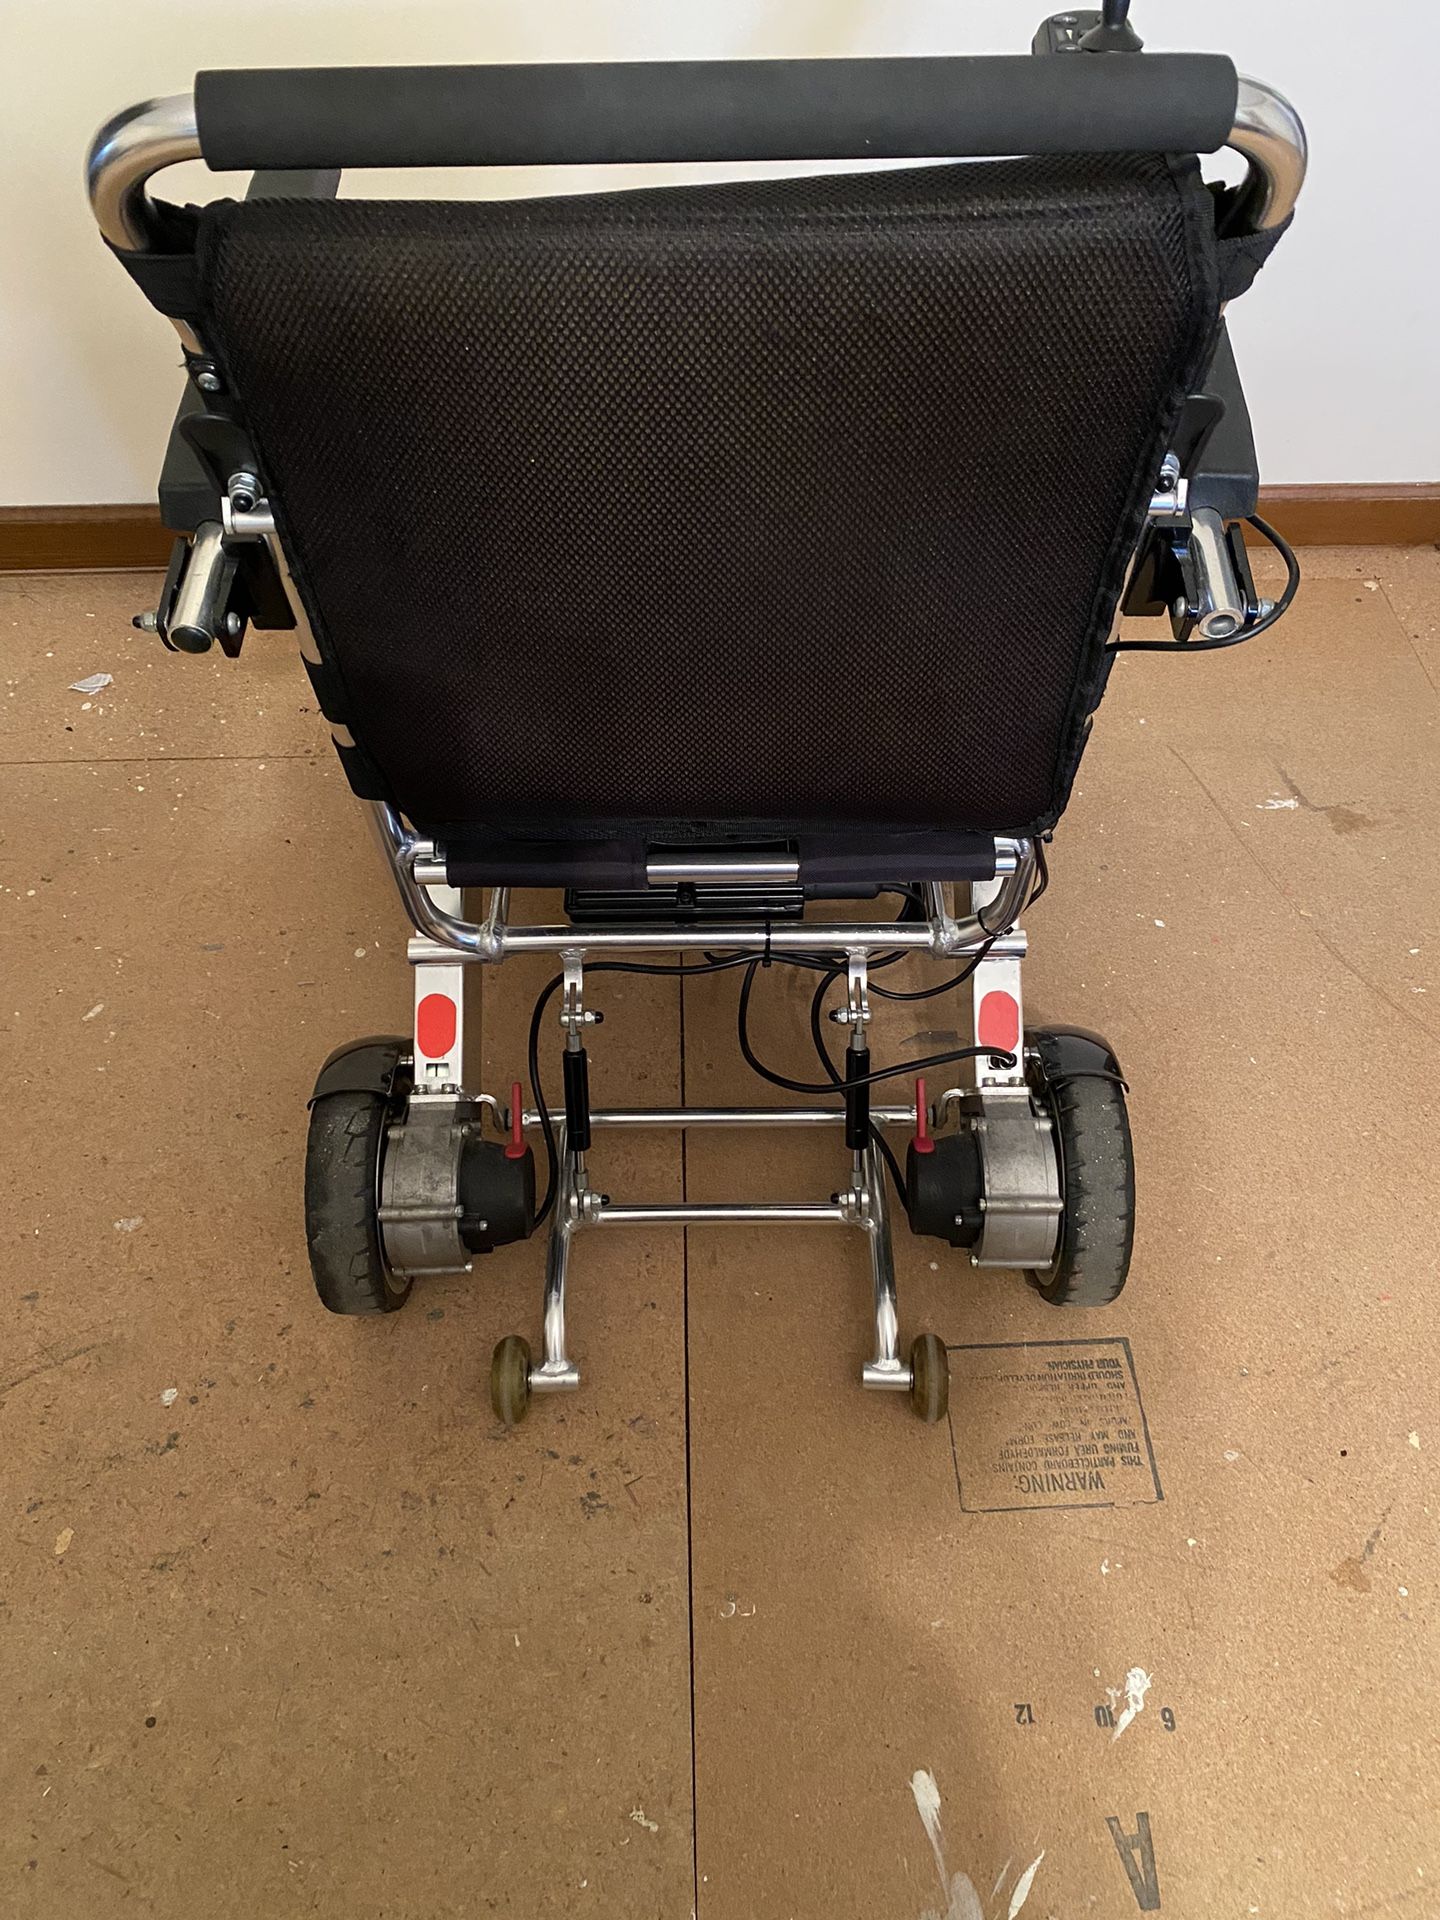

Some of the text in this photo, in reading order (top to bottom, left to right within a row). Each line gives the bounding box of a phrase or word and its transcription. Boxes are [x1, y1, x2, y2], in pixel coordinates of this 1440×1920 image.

[1096, 1358, 1121, 1369] YOUR
[1088, 1371, 1123, 1380] SHOULD
[1089, 1431, 1109, 1440] MAY
[1118, 1429, 1135, 1439] AND
[998, 1446, 1069, 1459] FORMALDEHYDE
[1074, 1444, 1098, 1456] UREA
[992, 1456, 1143, 1472] THIS PARTICLEBOARD CONTAINS
[1013, 1471, 1104, 1493] WARNING:
[1014, 1703, 1176, 1732] 6 10 12
[1105, 1812, 1161, 1912] A
